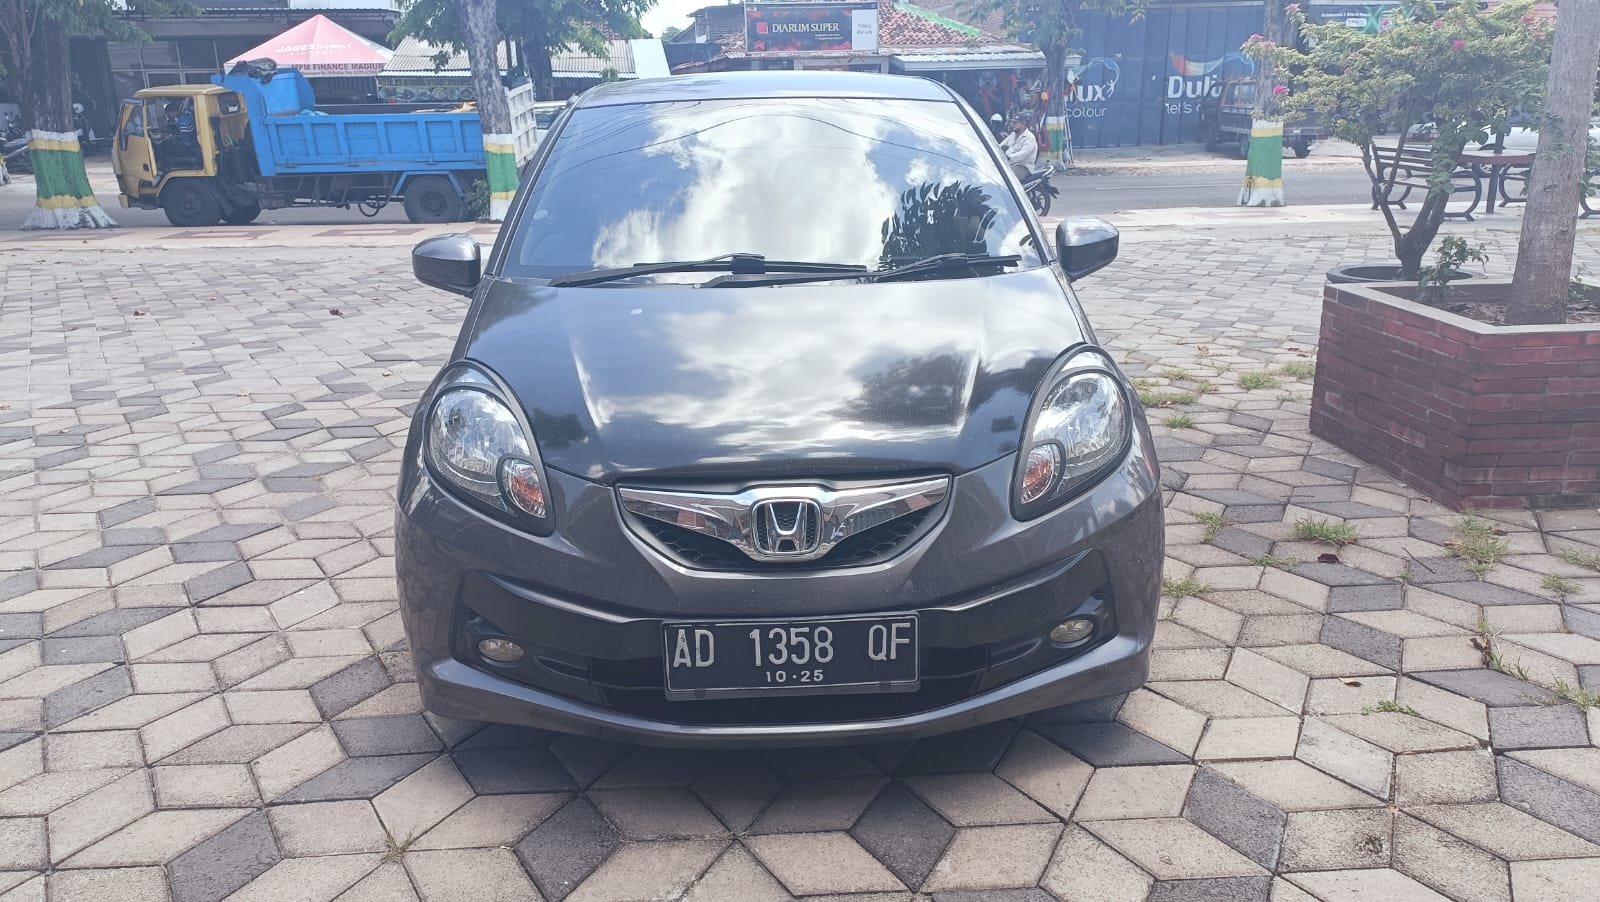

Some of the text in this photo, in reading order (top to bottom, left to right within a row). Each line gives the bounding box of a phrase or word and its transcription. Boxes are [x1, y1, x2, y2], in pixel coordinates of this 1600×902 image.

[772, 22, 840, 34] DJARUM SUPER
[312, 63, 350, 71] FINANCE
[672, 622, 912, 668] AD 1358 QF
